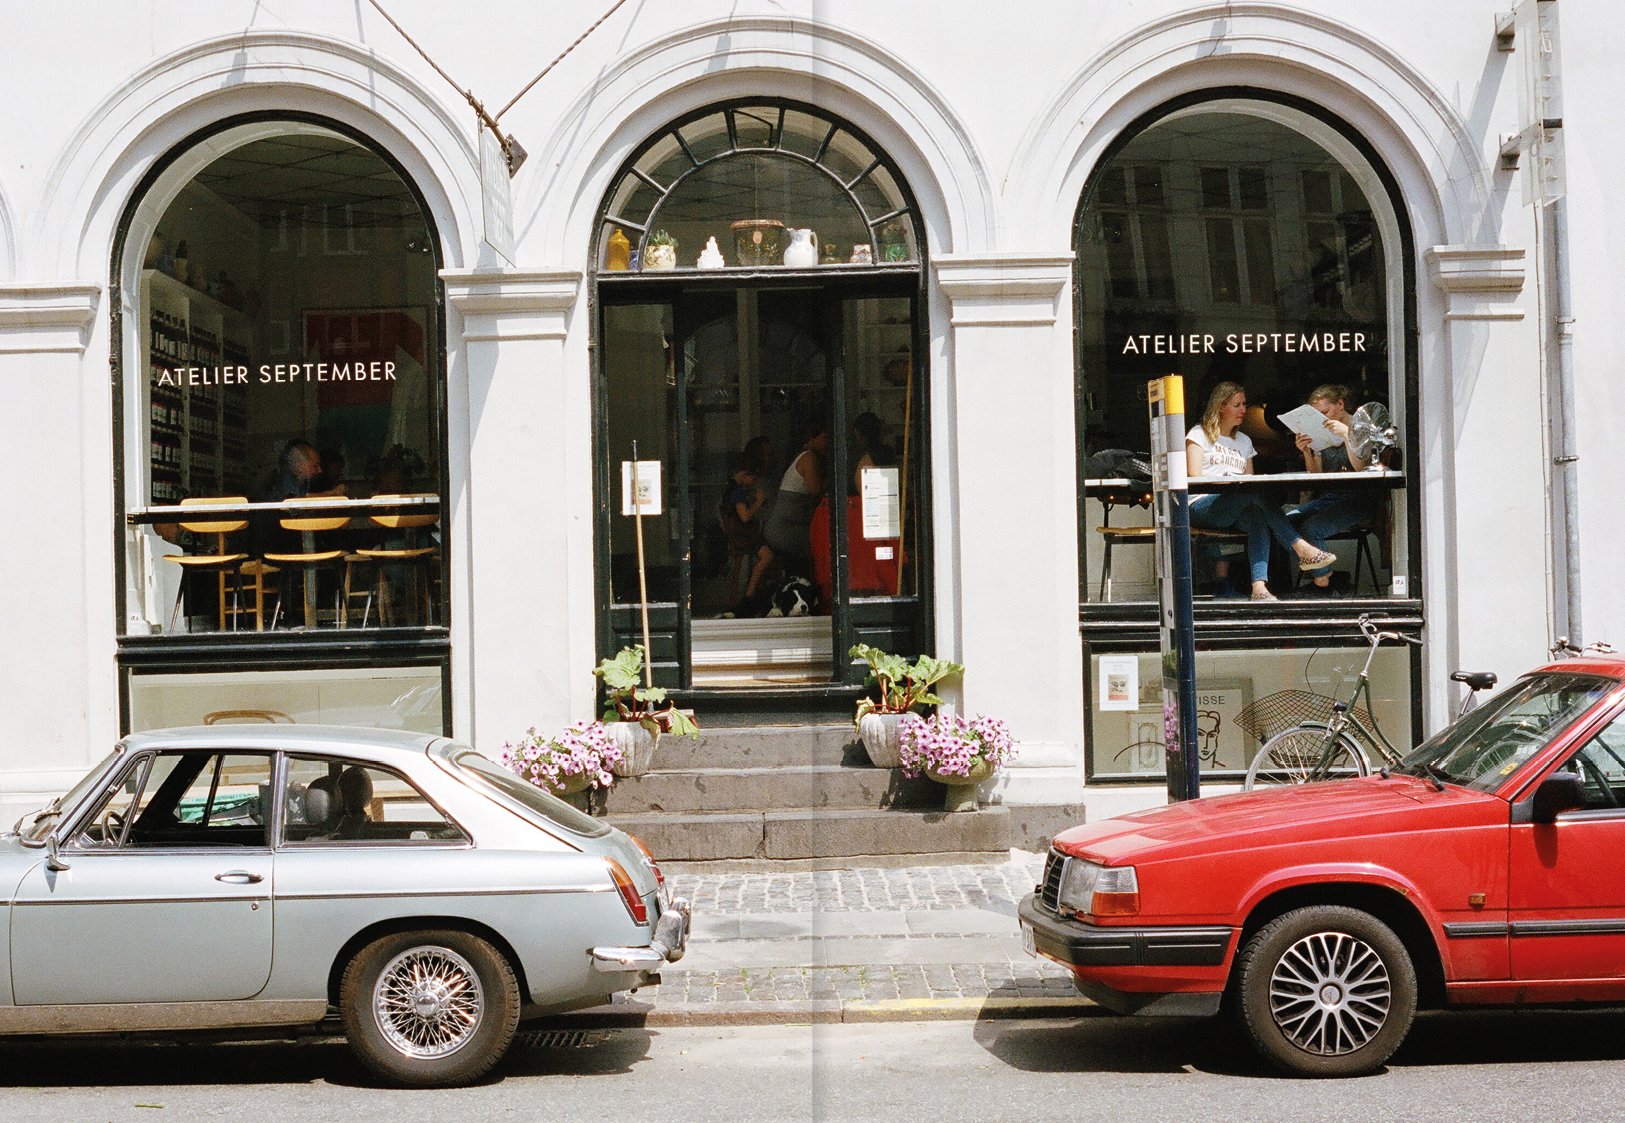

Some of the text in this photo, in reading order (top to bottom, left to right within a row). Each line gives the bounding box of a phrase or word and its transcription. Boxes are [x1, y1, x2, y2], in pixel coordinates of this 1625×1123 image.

[1122, 332, 1367, 355] ATELIER SEPTEMBER
[158, 361, 397, 387] ATELIER SEPTEMBER
[1198, 695, 1226, 705] ISSE
